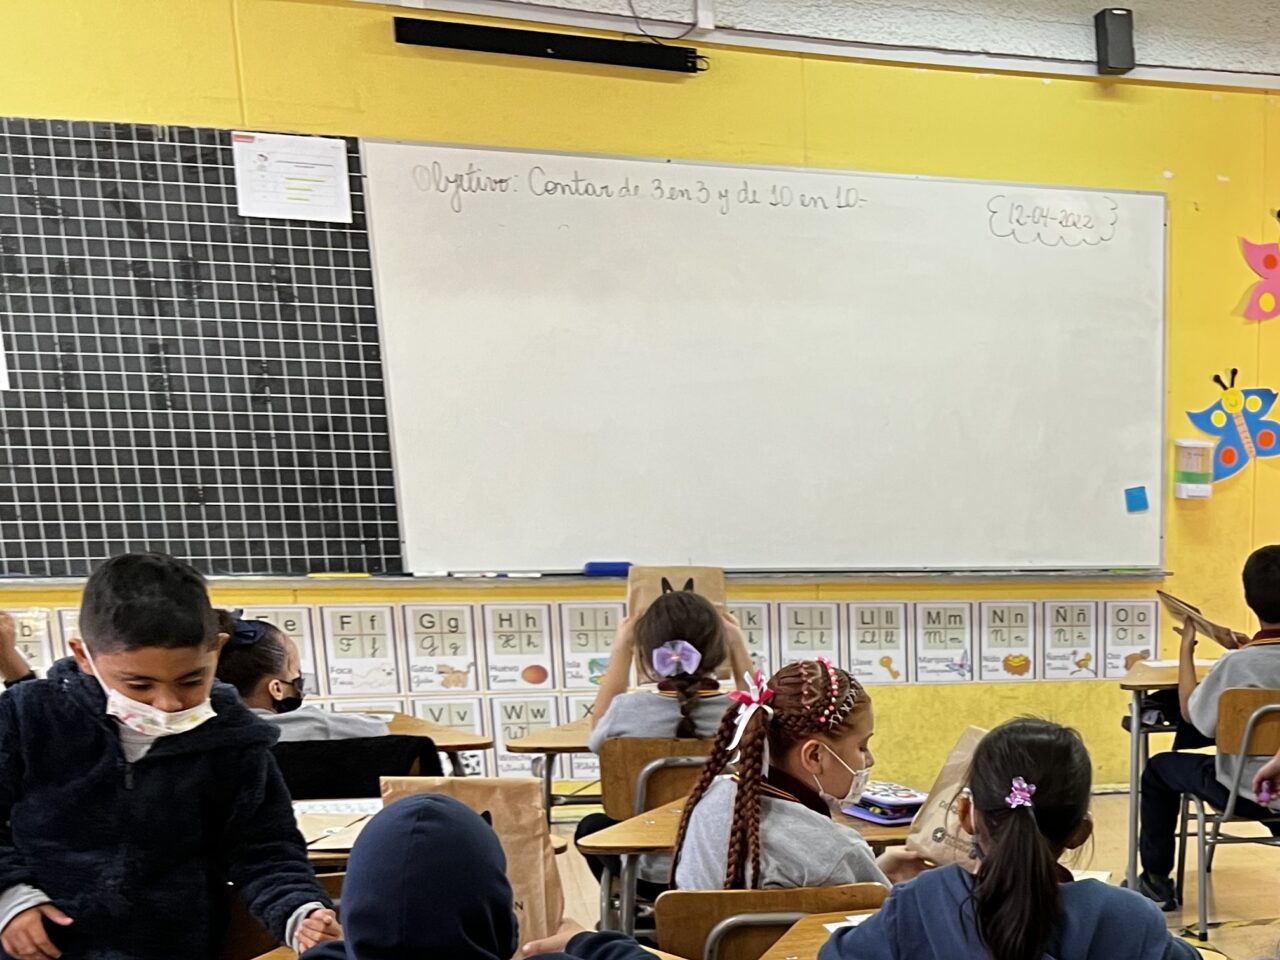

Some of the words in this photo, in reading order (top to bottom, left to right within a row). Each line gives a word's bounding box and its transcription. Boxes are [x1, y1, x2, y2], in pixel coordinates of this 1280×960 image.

[528, 166, 613, 197] Contar
[618, 176, 640, 197] de
[651, 178, 665, 200] 3
[696, 180, 710, 204] 3
[717, 189, 729, 216] y
[738, 181, 760, 204] de
[769, 185, 793, 207] 10
[800, 193, 830, 210] en
[1009, 202, 1095, 229] 12-04-2022
[498, 613, 513, 628] H
[525, 613, 537, 628] h
[604, 611, 609, 626] i
[746, 610, 758, 626] k
[794, 610, 805, 625] L
[860, 610, 875, 625] Ll
[885, 610, 894, 625] ll
[926, 610, 941, 625] M
[947, 614, 963, 625] m
[992, 609, 1005, 624] N
[1014, 612, 1025, 624] n
[1055, 606, 1068, 623] Ñ
[1076, 609, 1087, 623] ñ
[1115, 608, 1129, 623] O
[1136, 611, 1147, 623] o
[21, 621, 32, 637] b
[284, 618, 297, 632] e
[339, 615, 352, 631] F
[369, 615, 377, 630] f
[419, 613, 436, 630] G
[447, 617, 459, 633] g
[428, 707, 444, 723] V
[456, 710, 468, 722] v
[503, 705, 524, 720] W
[530, 708, 547, 719] w
[582, 703, 595, 718] X
